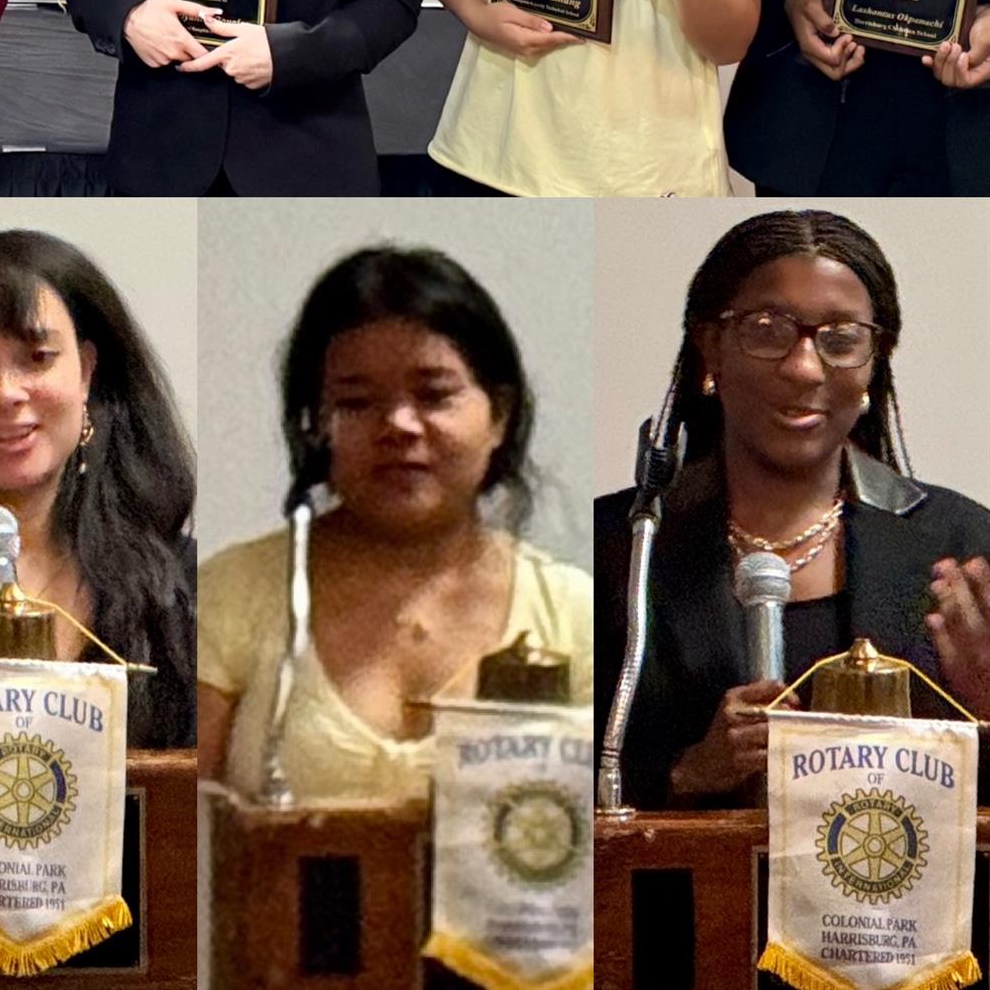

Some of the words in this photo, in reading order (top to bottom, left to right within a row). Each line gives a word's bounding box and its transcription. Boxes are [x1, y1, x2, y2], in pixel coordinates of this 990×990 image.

[43, 690, 104, 733] CLUB
[15, 716, 33, 729] OF
[792, 744, 888, 781] ROTARY
[895, 747, 955, 789] CLUB
[867, 772, 885, 786] OF
[853, 799, 898, 815] ROTARY
[36, 863, 67, 878] PARK
[51, 881, 66, 894] PA
[822, 914, 886, 931] COLONIAL
[886, 918, 917, 932] PARK
[901, 935, 917, 949] PA
[821, 947, 894, 964] CHARTERED
[895, 952, 916, 966] 1951
